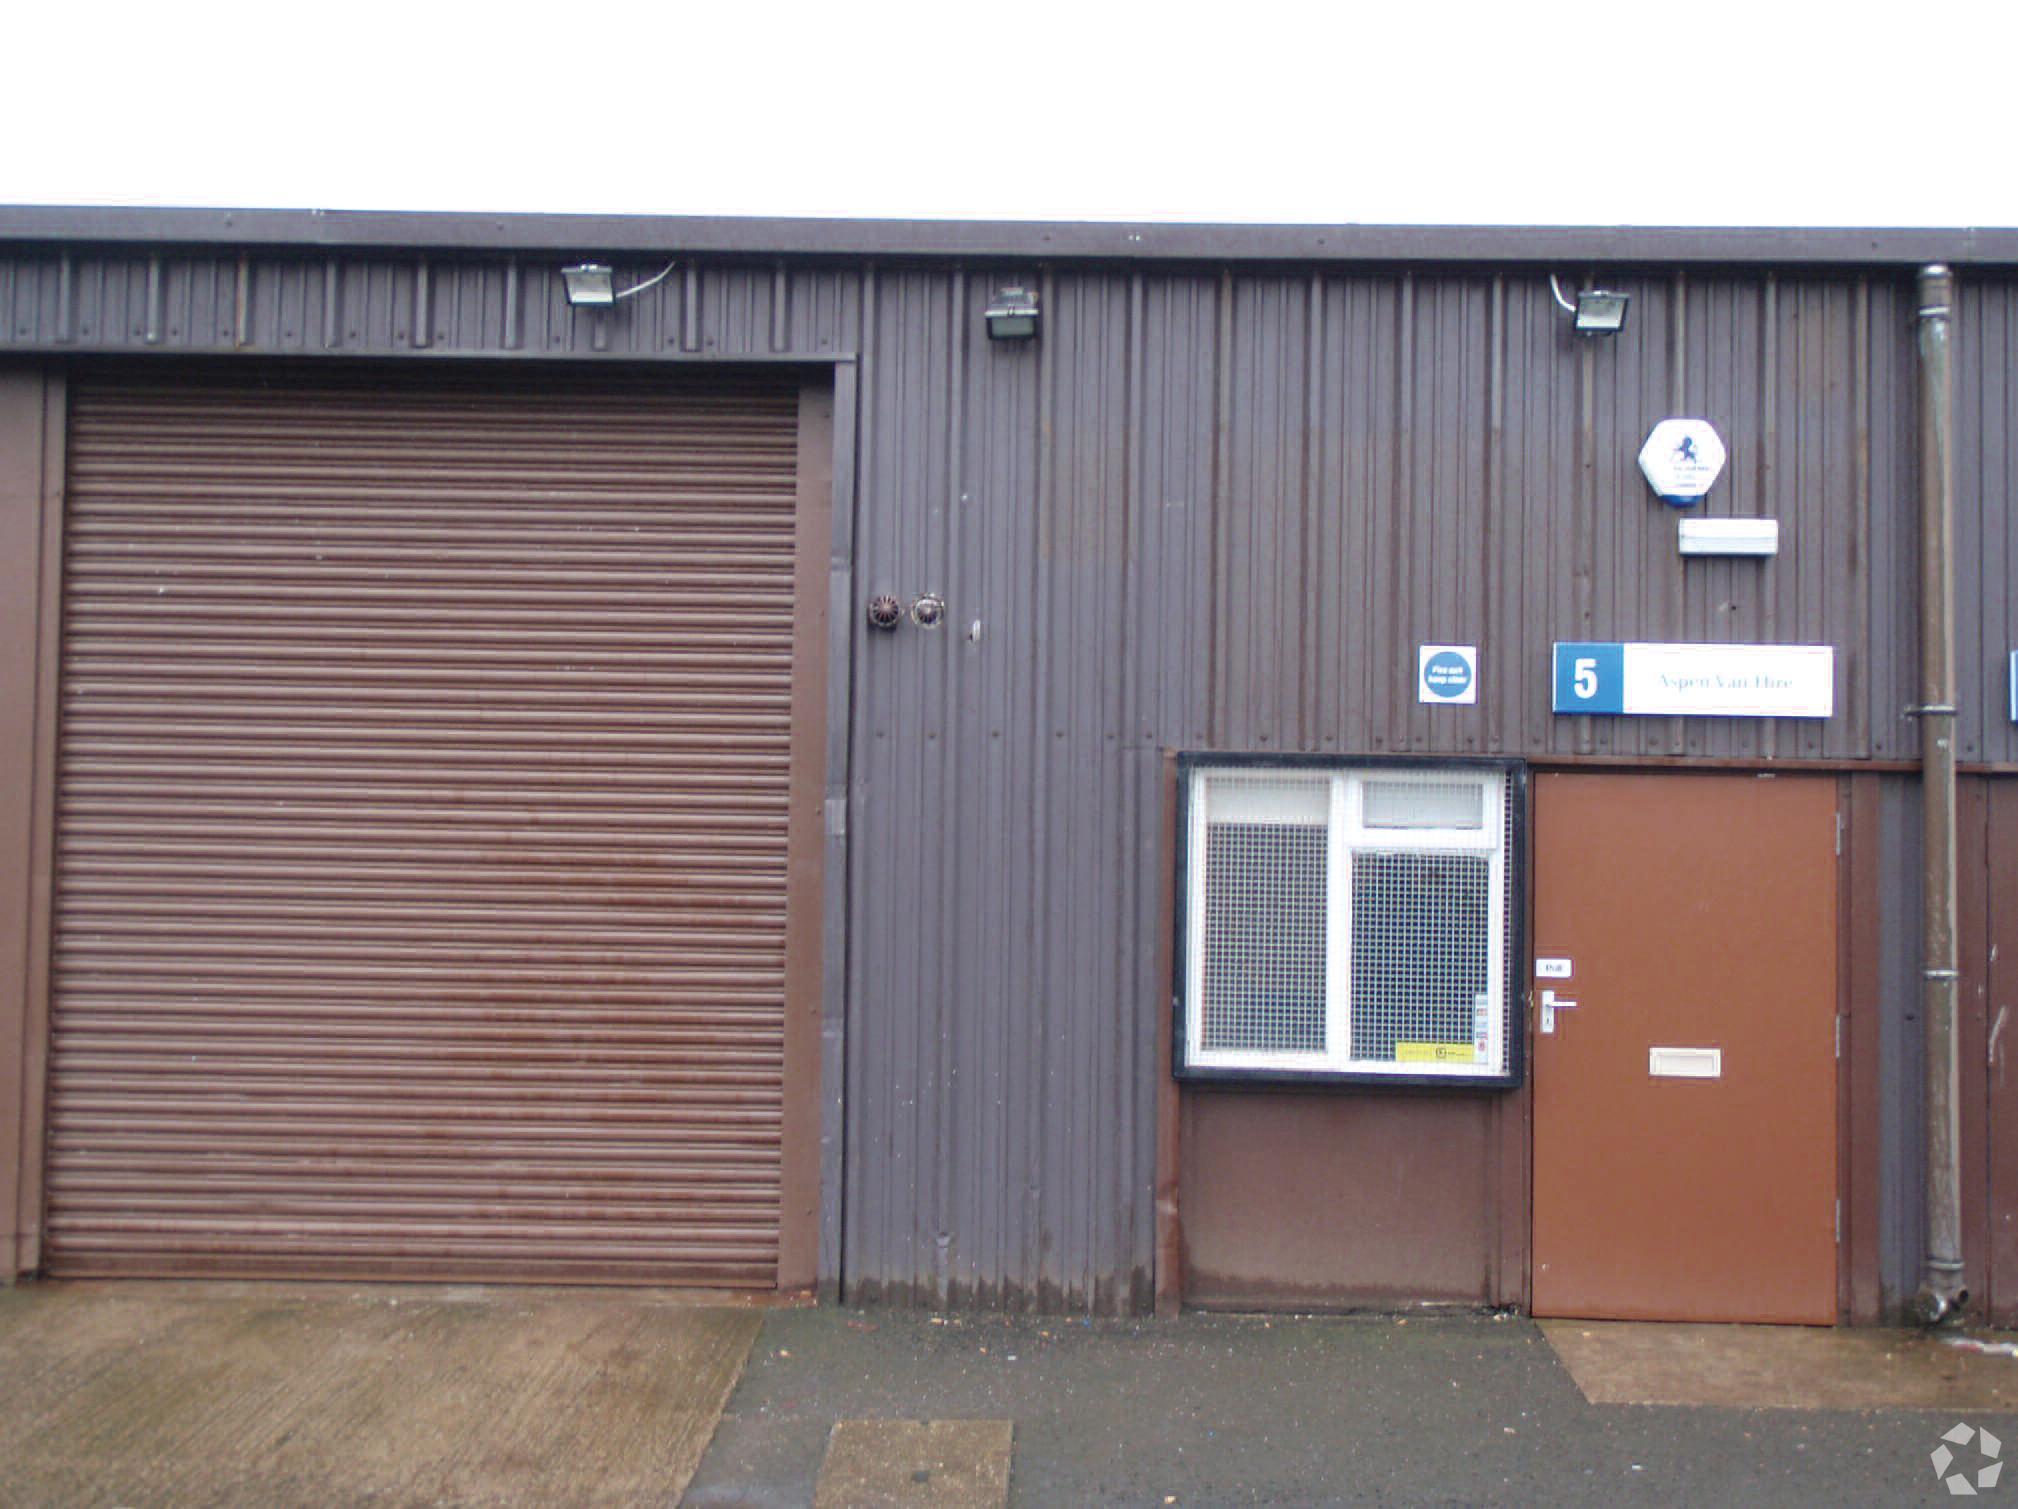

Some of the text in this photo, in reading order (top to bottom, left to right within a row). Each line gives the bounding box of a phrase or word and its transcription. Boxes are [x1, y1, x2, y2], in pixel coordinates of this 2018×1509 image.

[1574, 658, 1598, 699] 5
[1658, 673, 1710, 694] Aspen
[1714, 673, 1748, 689] Van
